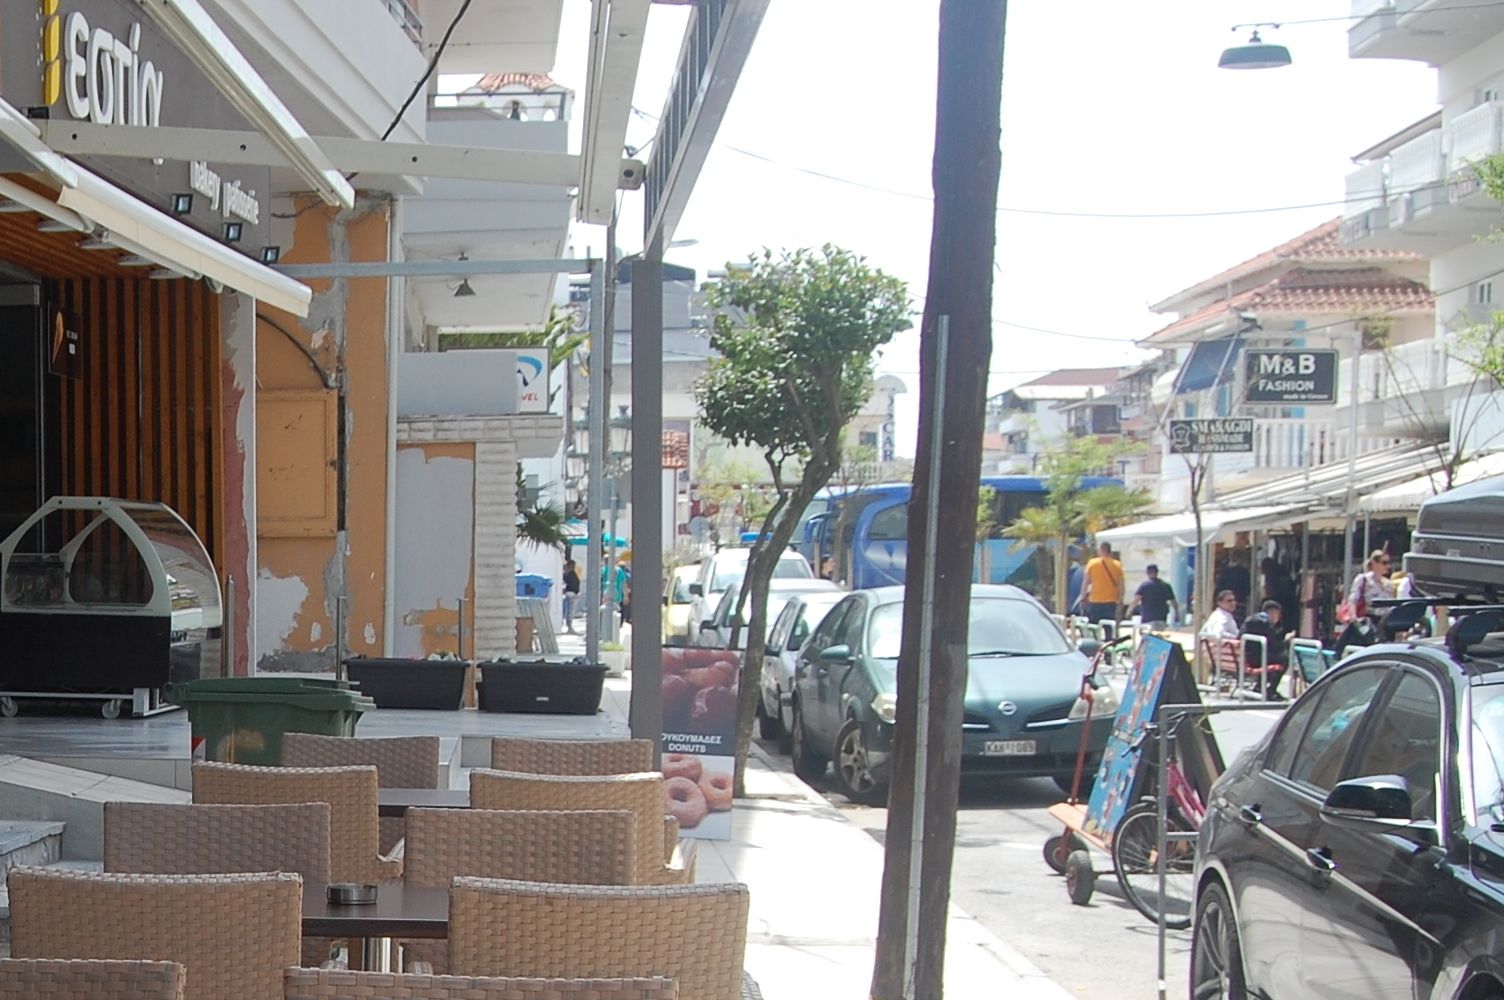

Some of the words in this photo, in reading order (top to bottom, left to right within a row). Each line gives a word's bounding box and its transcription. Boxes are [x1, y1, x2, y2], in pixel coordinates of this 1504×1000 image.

[1259, 354, 1316, 375] M&B
[1258, 380, 1314, 391] FASHION
[661, 732, 722, 744] ΟΥΚΟΥΜΑΔΕΣ
[668, 743, 707, 753] DONUTS
